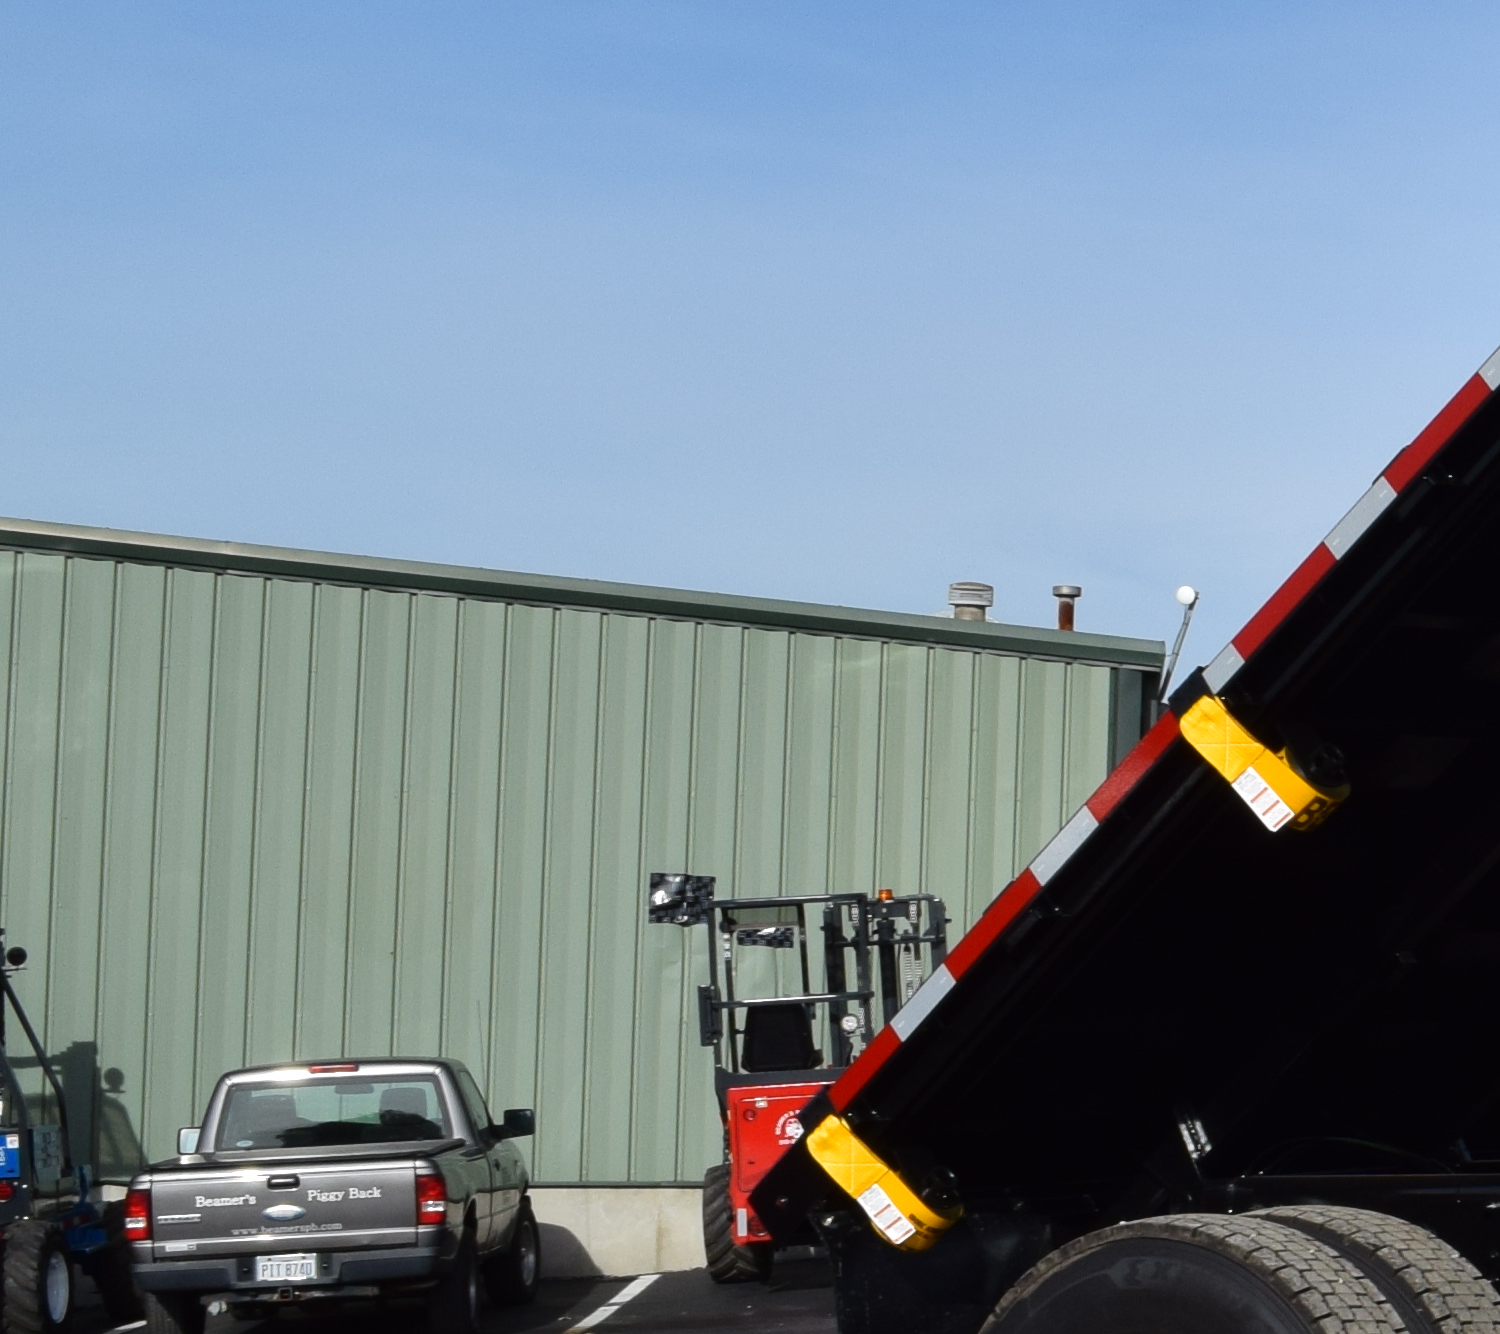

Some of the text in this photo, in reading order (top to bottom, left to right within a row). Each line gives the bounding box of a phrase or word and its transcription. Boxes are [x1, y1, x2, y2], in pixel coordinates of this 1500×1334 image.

[195, 1186, 382, 1208] Beamer's Piggy Back
[230, 1222, 343, 1236] www.beamerspb.com
